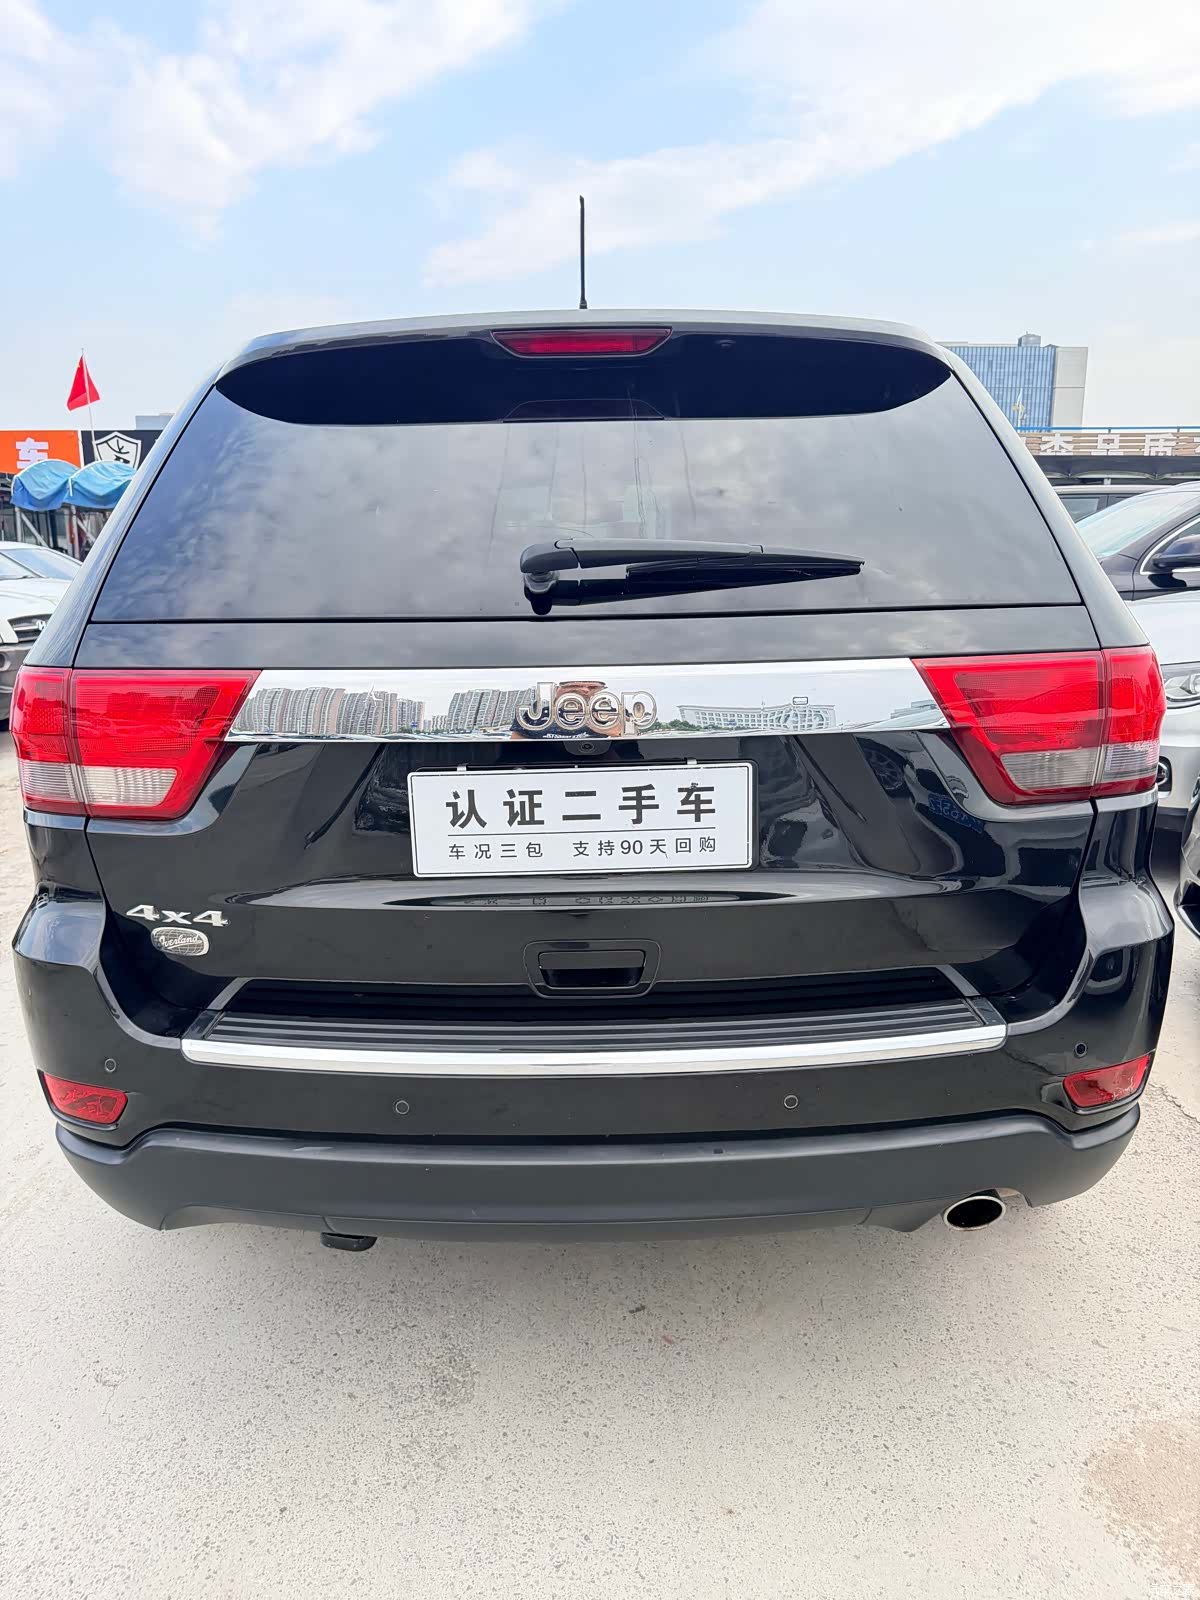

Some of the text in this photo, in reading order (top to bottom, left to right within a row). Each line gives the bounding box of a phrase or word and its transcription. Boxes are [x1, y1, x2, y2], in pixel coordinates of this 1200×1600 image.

[516, 682, 658, 736] Jeep
[445, 783, 717, 829] 认证二手车
[448, 835, 717, 861] 车况三包 支持90天回购
